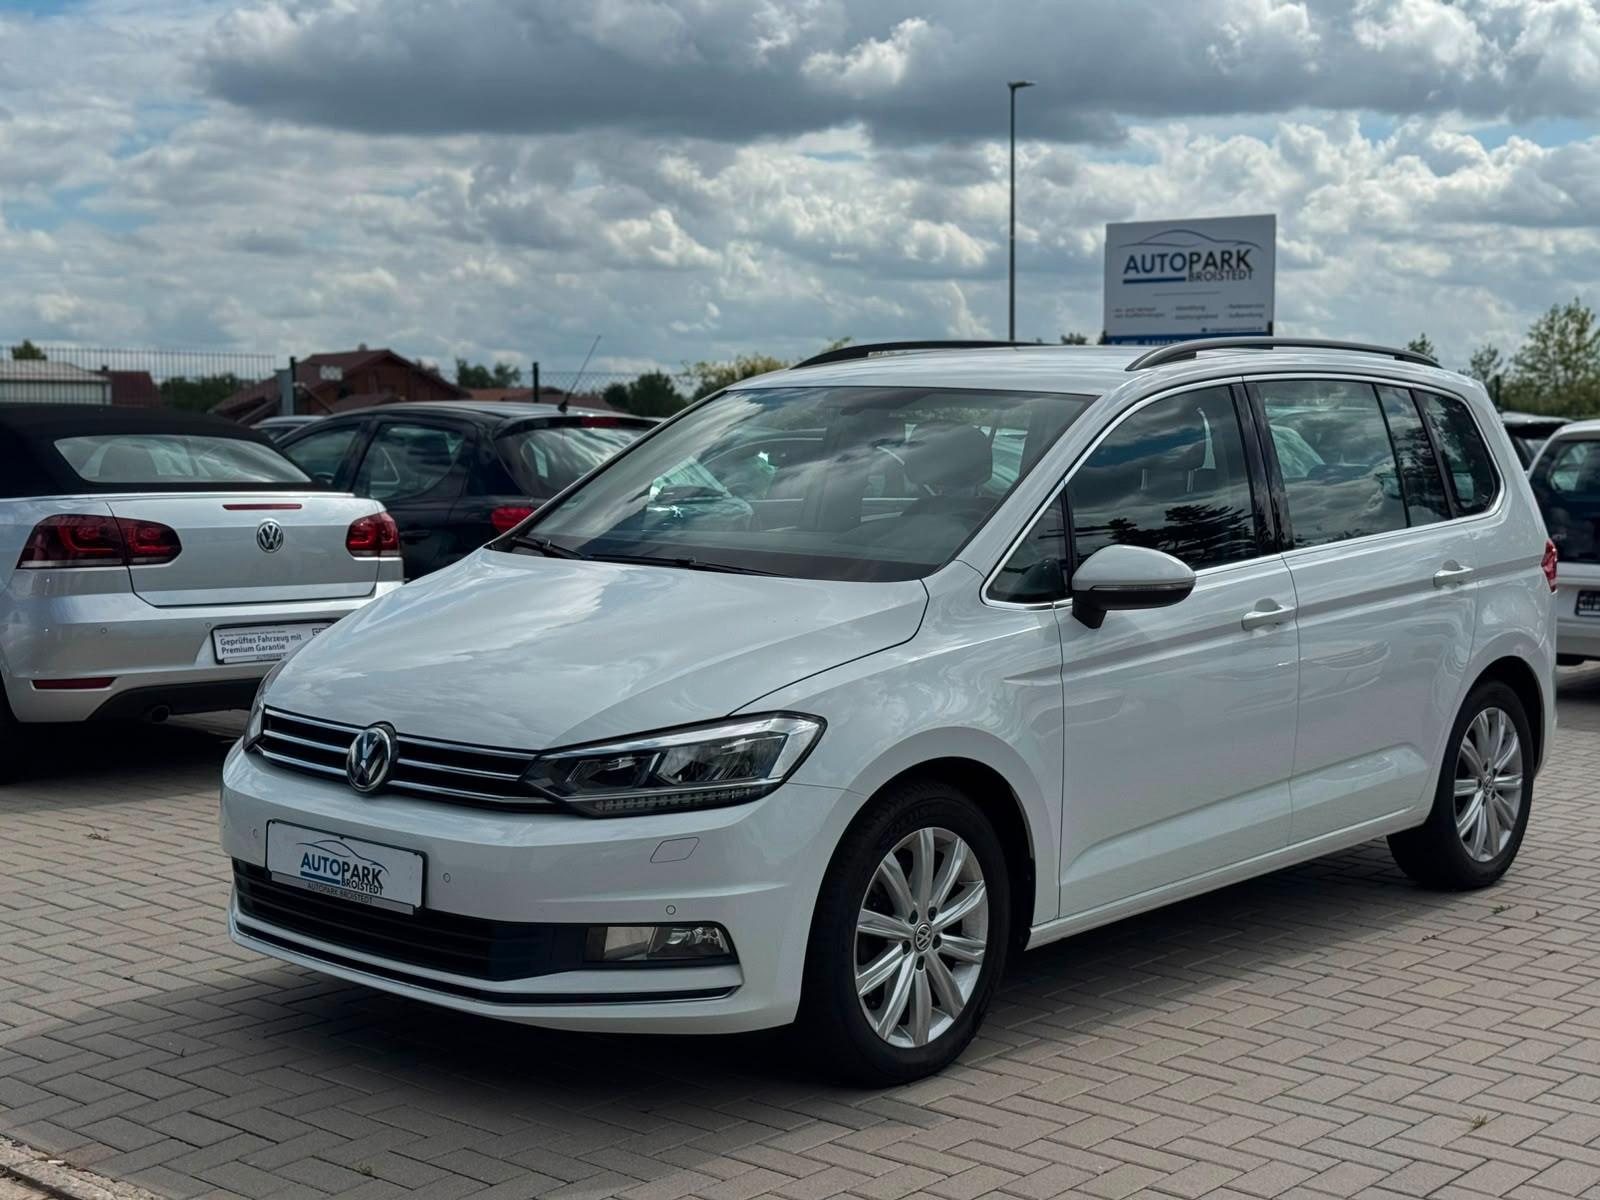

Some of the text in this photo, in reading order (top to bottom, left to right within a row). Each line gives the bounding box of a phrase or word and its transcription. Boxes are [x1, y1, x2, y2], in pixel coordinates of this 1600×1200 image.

[1123, 249, 1253, 275] AUTOPARK
[1188, 268, 1253, 283] BROISTEDT
[220, 636, 256, 646] Geprüftes
[257, 635, 289, 643] Fahrzeug
[290, 633, 302, 641] mit
[221, 643, 286, 655] Premium Garantie
[300, 852, 385, 888] AUTOPARK
[307, 883, 373, 904] AUTOPARK BROISTEDT
[341, 878, 385, 896] BROISTEDT
